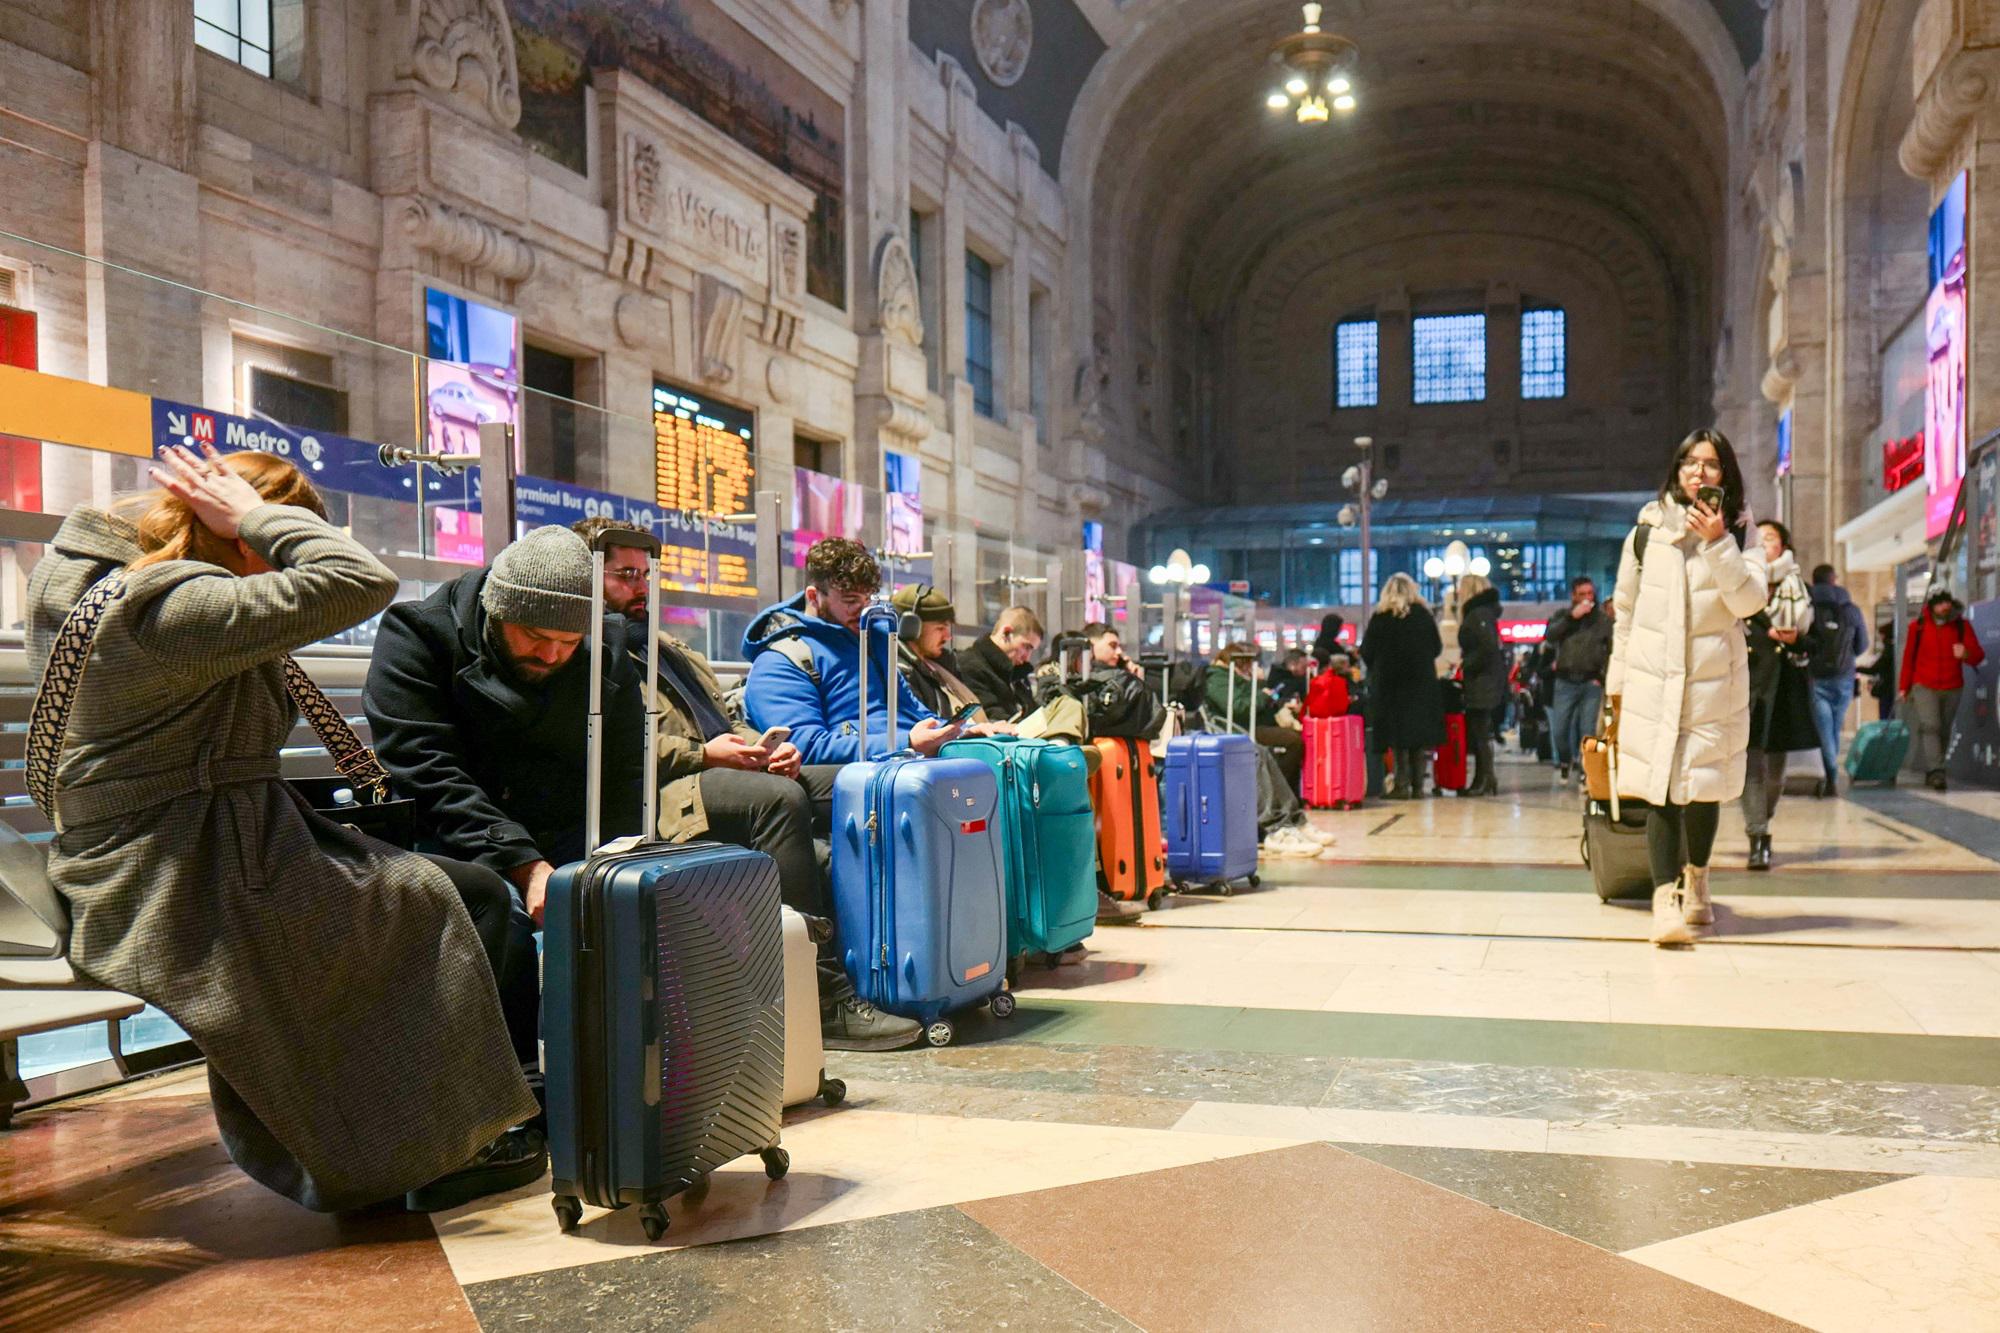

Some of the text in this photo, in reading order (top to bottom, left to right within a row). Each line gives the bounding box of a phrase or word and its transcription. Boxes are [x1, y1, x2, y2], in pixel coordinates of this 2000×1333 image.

[194, 418, 290, 455] M Metro
[516, 486, 582, 510] erminal Bus
